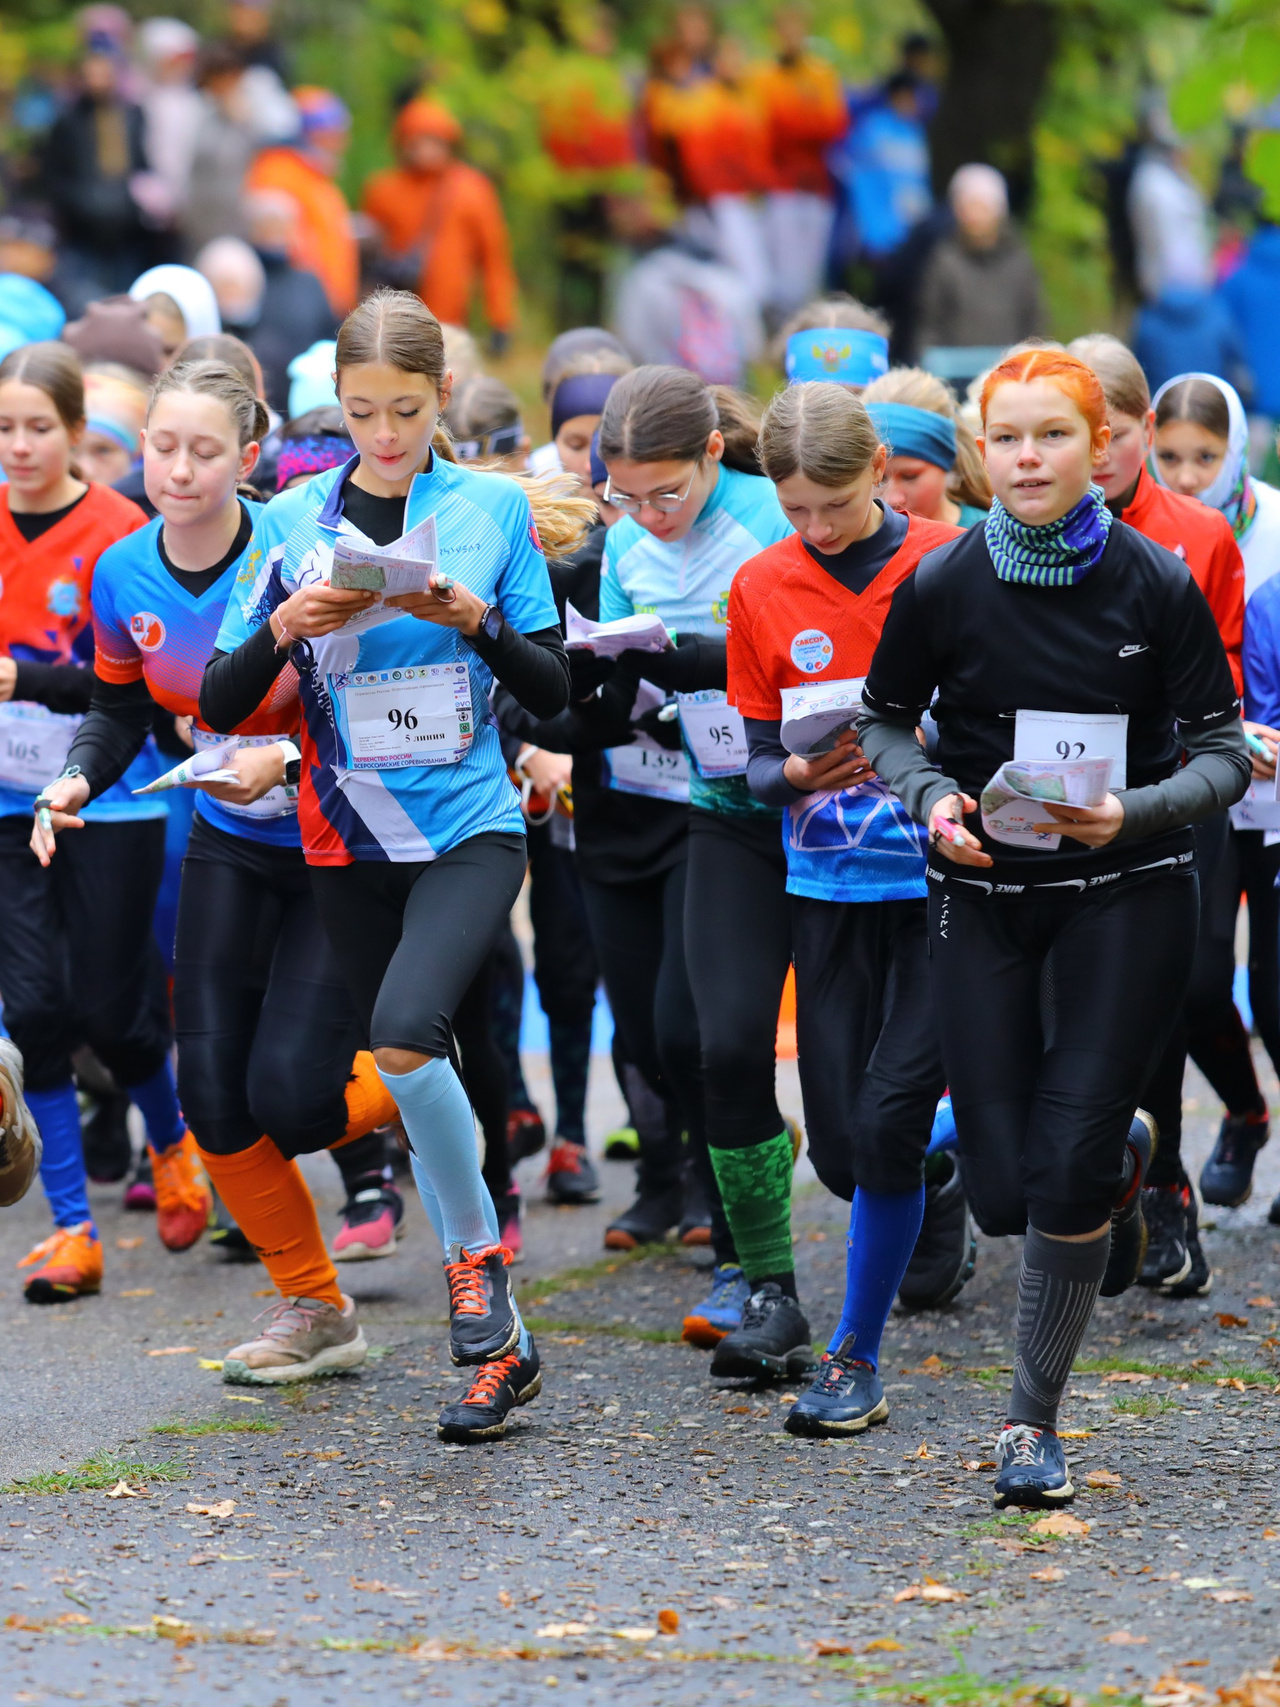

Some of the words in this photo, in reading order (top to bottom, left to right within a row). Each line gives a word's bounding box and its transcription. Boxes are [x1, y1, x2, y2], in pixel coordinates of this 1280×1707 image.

[387, 706, 419, 732] 96
[405, 734, 411, 743] 5
[413, 733, 445, 742] линия
[709, 726, 733, 746] 95
[401, 757, 447, 766] СОРЕВНОВАНИЯ
[927, 867, 946, 883] NIKE
[1088, 872, 1122, 887] NIKE
[993, 883, 1026, 895] NIKE
